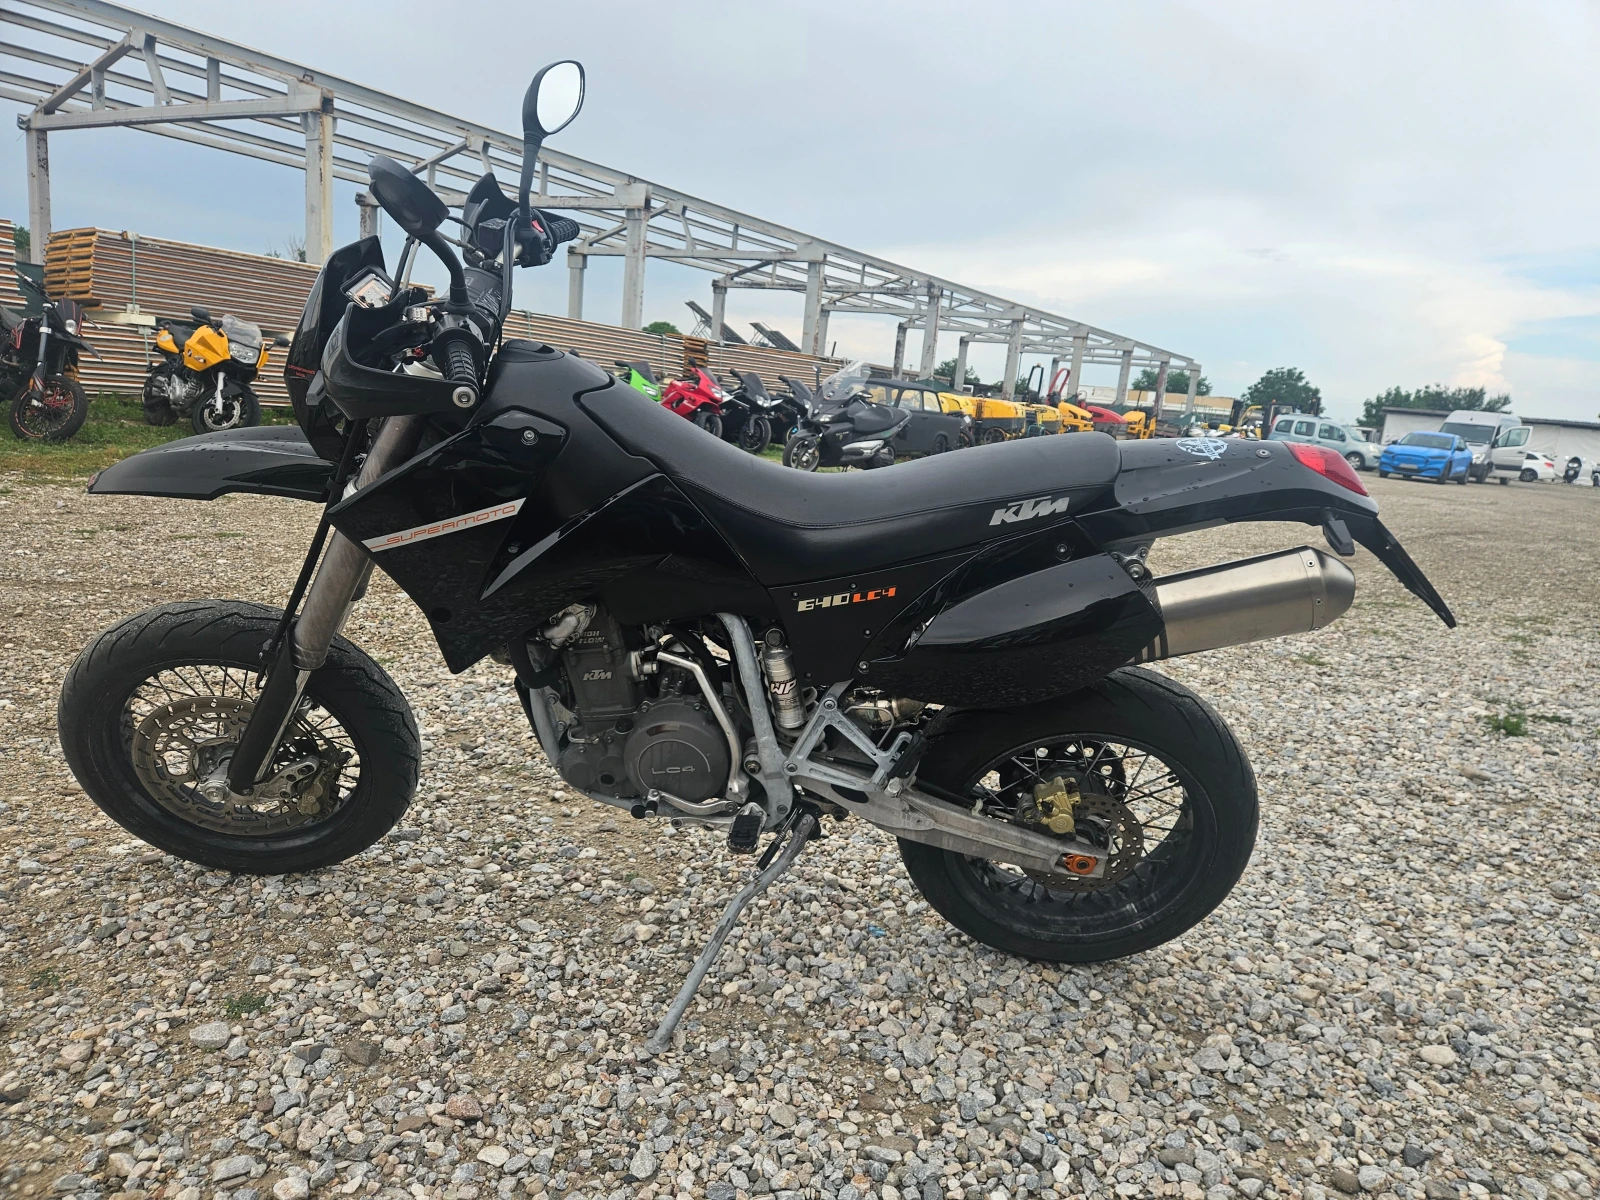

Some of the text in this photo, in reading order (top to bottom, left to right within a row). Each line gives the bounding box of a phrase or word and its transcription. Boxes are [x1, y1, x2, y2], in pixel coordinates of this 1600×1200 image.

[989, 496, 1069, 526] KTM
[386, 505, 516, 544] SUPERMOTO
[583, 669, 613, 681] KTM
[770, 679, 797, 695] WP
[651, 765, 696, 775] LC4
